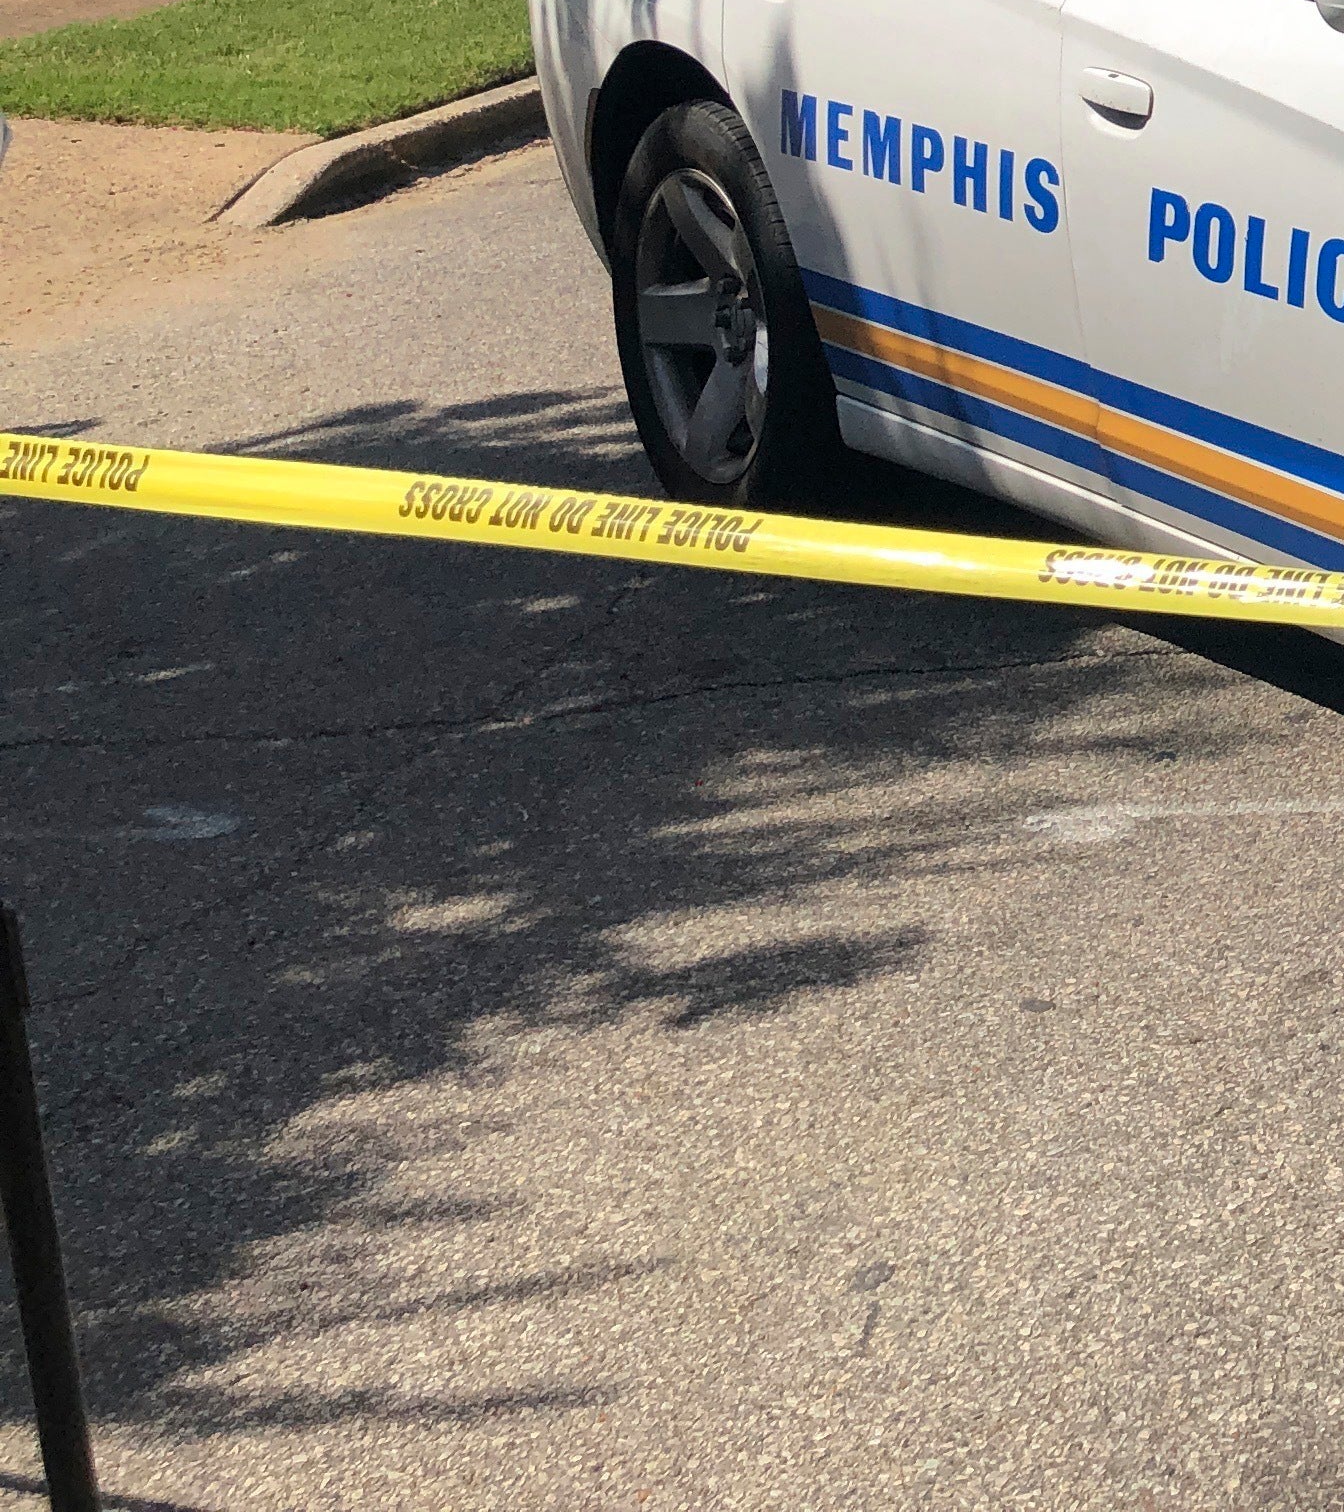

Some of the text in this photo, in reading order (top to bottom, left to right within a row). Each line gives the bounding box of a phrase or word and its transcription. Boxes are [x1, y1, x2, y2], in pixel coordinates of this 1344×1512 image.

[780, 89, 1060, 233] MEMPHIS
[0, 441, 150, 492] POLICE LINE
[398, 480, 763, 553] POLICE LINE DO NOT CROSS
